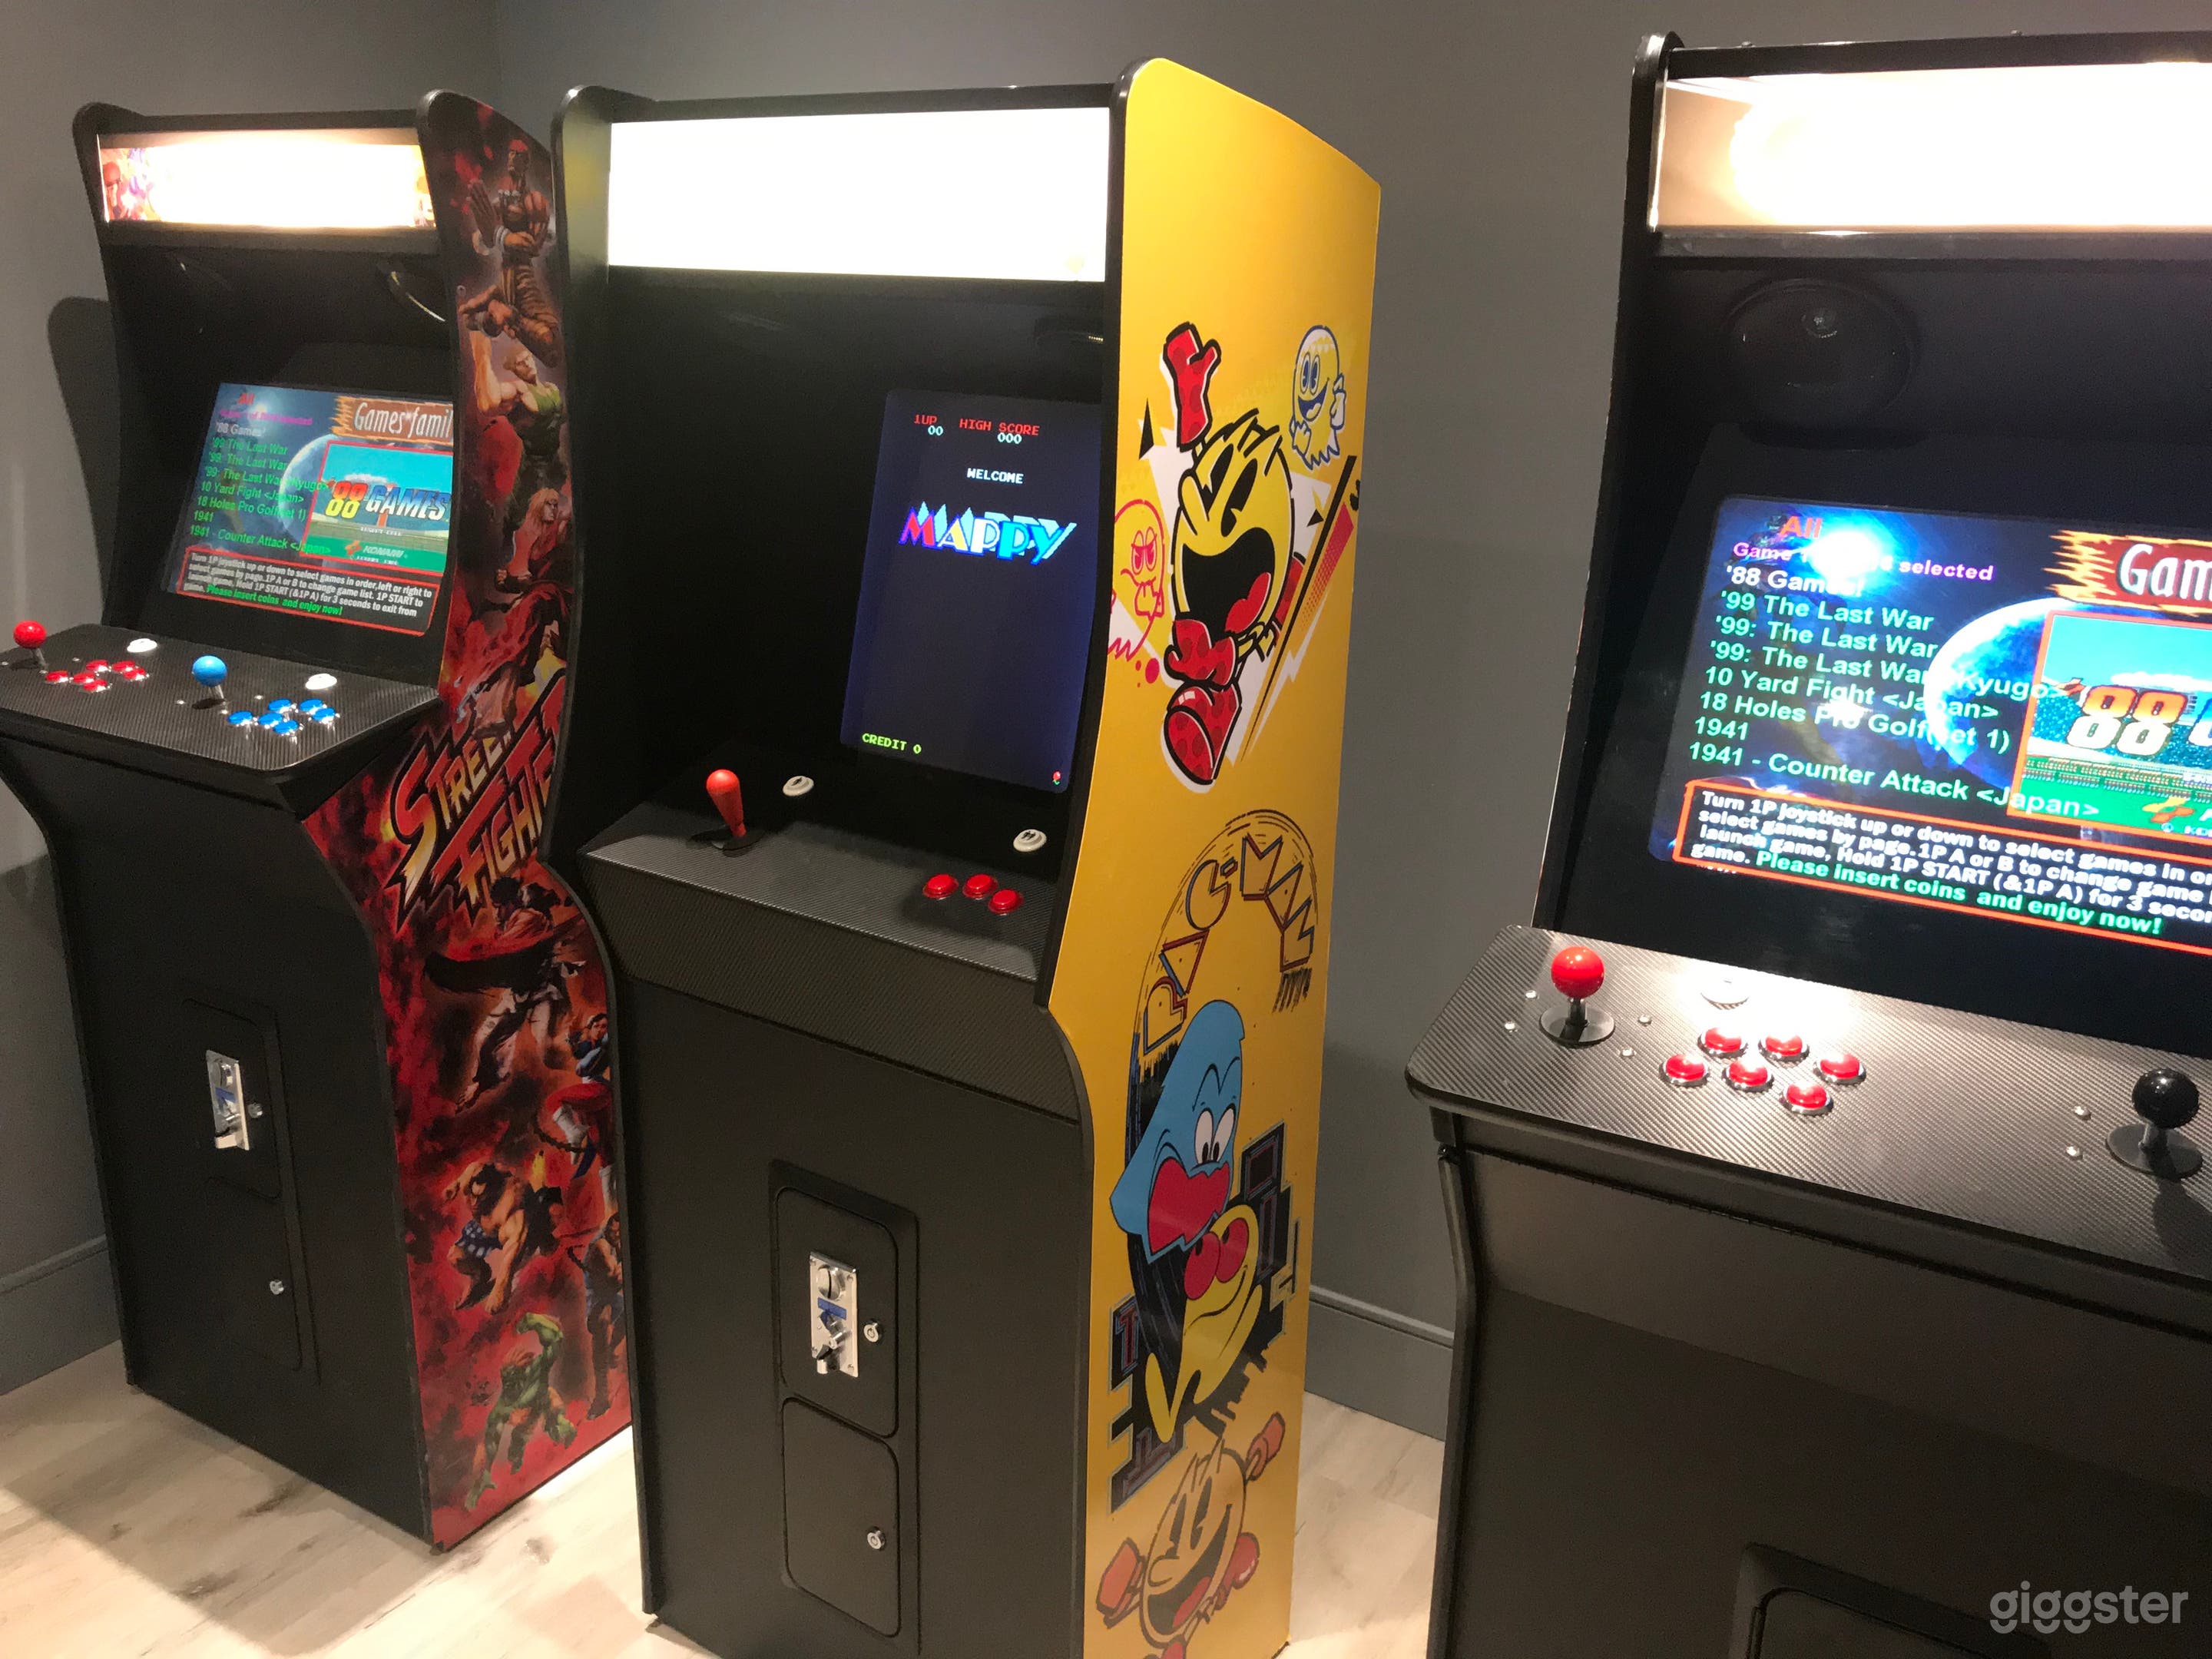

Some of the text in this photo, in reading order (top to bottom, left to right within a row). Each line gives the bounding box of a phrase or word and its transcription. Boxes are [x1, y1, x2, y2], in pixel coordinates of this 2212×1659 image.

[237, 392, 255, 405] All
[354, 402, 405, 435] Games
[913, 414, 1041, 437] 1UP HIGH SCORE
[928, 425, 1022, 445] 00 000
[227, 452, 288, 470] The Last War
[228, 439, 243, 450] The
[247, 441, 267, 453] Last
[269, 443, 288, 455] War
[201, 481, 211, 492] 10
[214, 483, 234, 495] Yard
[237, 487, 261, 500] Fight
[223, 468, 240, 481] The
[242, 470, 262, 483] Last
[967, 467, 1025, 485] WELCOME
[194, 511, 214, 522] 1941
[197, 495, 207, 507] 18
[209, 498, 236, 511] Holes
[238, 501, 254, 513] Pro
[366, 485, 452, 522] GAMES
[190, 525, 210, 538] 1941
[218, 528, 255, 543] Counter
[257, 535, 288, 549] Attack
[898, 503, 1074, 565] MAPPY
[1780, 515, 1823, 538] All
[1726, 565, 1761, 585] '88
[1733, 541, 1793, 561] Game
[1899, 559, 1995, 581] selected
[235, 570, 244, 580] by
[276, 576, 282, 584] A
[292, 578, 298, 587] B
[299, 580, 307, 589] to
[307, 581, 336, 594] change
[336, 586, 359, 598] game
[359, 588, 374, 599] list.
[376, 592, 388, 601] 1P
[388, 594, 414, 606] START
[415, 598, 424, 608] to
[247, 562, 257, 572] up
[267, 564, 286, 575] down
[286, 568, 295, 576] to
[296, 569, 319, 581] select
[320, 573, 345, 584] games
[346, 577, 354, 585] in
[393, 584, 402, 594] or
[402, 584, 422, 597] right
[423, 589, 432, 598] to
[206, 584, 233, 597] Please
[233, 588, 257, 602] insert
[257, 594, 280, 605] coins
[282, 598, 298, 608] and
[299, 601, 321, 614] enjoy
[255, 582, 265, 591] 1P
[265, 585, 289, 596] START
[310, 591, 320, 602] A)
[320, 593, 331, 604] for
[339, 598, 372, 610] seconds
[373, 601, 380, 611] to
[382, 604, 397, 614] exit
[398, 605, 417, 618] from
[1721, 590, 1935, 631] '99 The Last War
[1716, 614, 1939, 659] '99: The Last War
[1710, 640, 1752, 663] '99:
[1763, 645, 1808, 670] The
[1816, 653, 1873, 678] Last
[1705, 666, 1734, 686] 10
[1741, 670, 1798, 696] Yard
[1806, 676, 1876, 707] Fight
[1694, 717, 1749, 740] 1941
[1700, 691, 2011, 754] 18 Holes Pro 1)
[862, 733, 922, 755] CREDIT 0
[1690, 742, 2101, 818] 1941 Counter Attack <Japan>
[1702, 790, 2185, 882] Turn 1P joystick up or down to select games in
[1698, 809, 1760, 831] select
[1761, 818, 1828, 842] games
[1832, 828, 1856, 848] by
[1947, 847, 1965, 865] A
[1969, 853, 1994, 869] or
[1996, 855, 2015, 873] B
[2018, 859, 2043, 877] to
[2046, 864, 2133, 892] change
[2135, 879, 2205, 903] game
[1700, 824, 1767, 849] launch
[1769, 838, 1832, 862] game,
[1836, 847, 1884, 868] Hold
[1889, 856, 1919, 873] 1P
[1921, 860, 1991, 886] START
[2056, 882, 2084, 904] A)
[2088, 887, 2124, 908] for
[2126, 894, 2143, 912] 3
[1690, 842, 1751, 864] game.
[1756, 850, 1830, 878] Please
[1833, 863, 1900, 890] insert
[1903, 878, 1967, 902] coins
[1976, 889, 2023, 911] and
[2028, 898, 2095, 926] enjoy
[2099, 911, 2163, 935] now!
